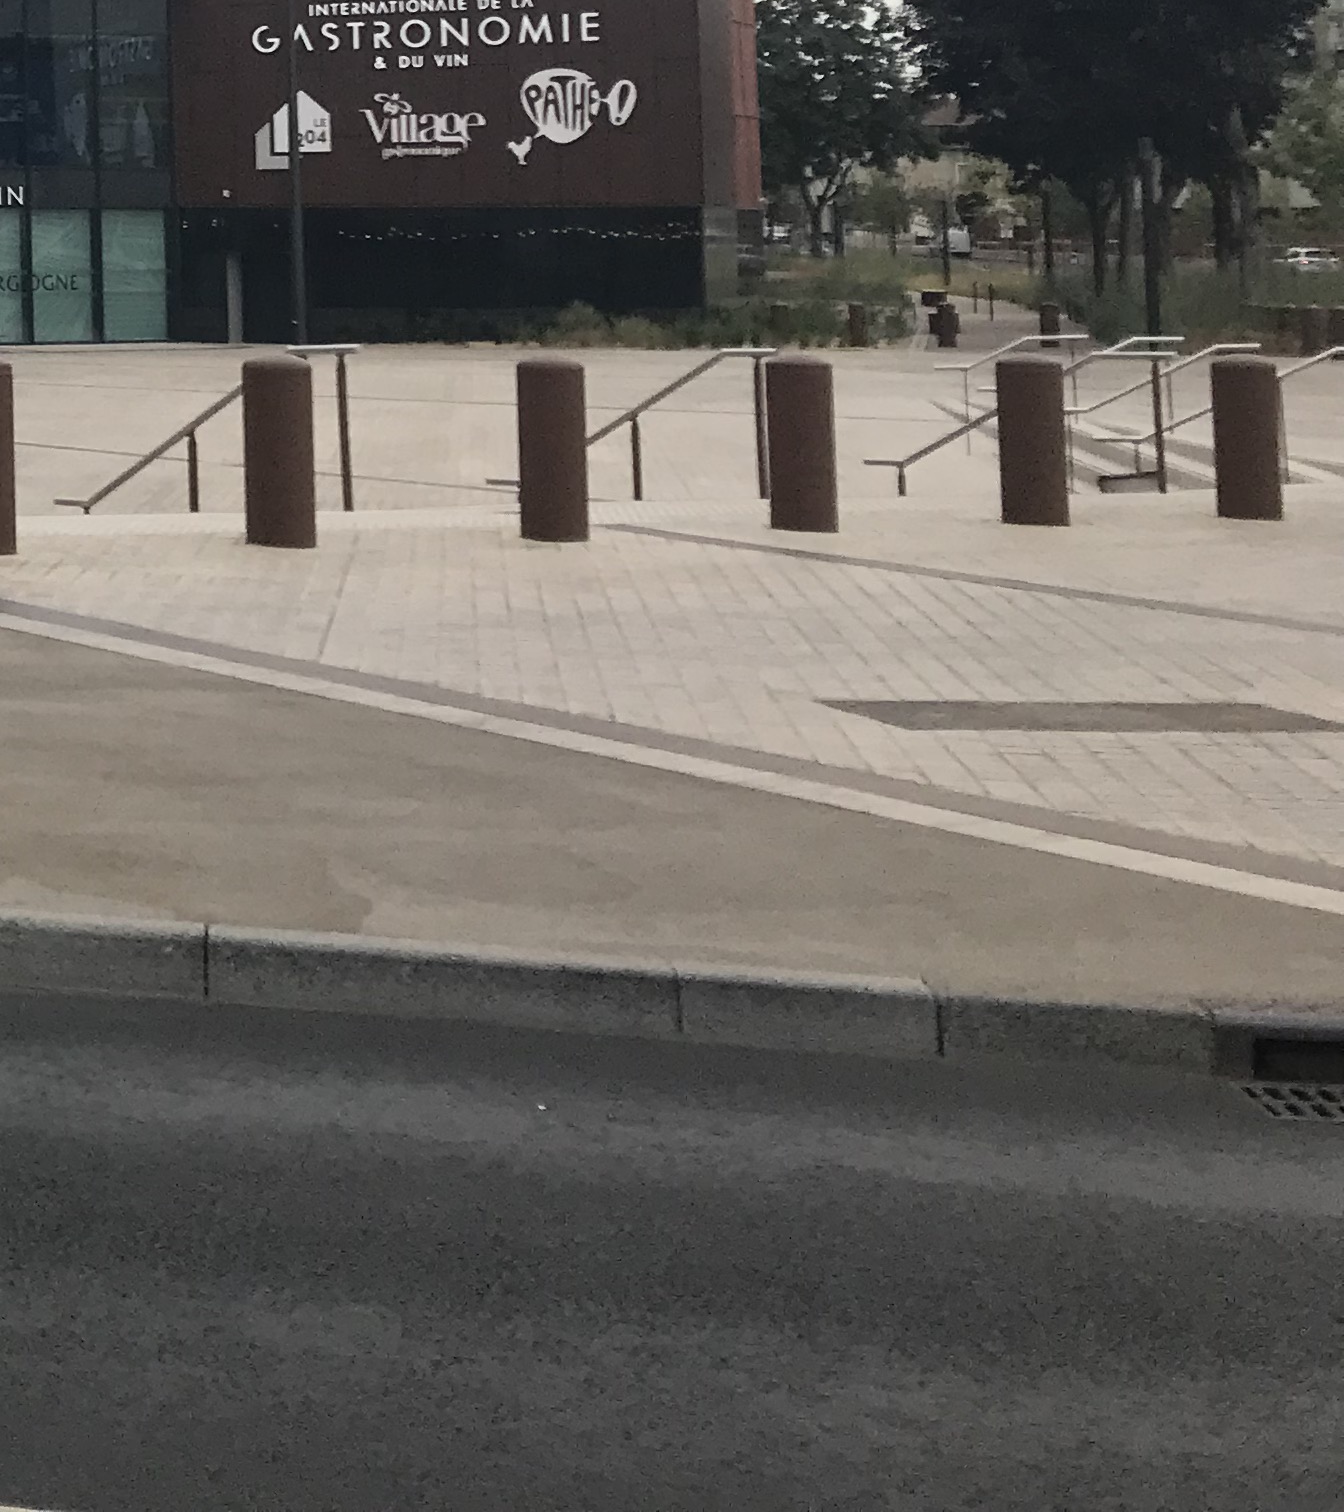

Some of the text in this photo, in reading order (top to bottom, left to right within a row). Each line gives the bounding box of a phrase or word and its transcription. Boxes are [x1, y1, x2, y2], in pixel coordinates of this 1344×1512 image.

[251, 11, 601, 54] GASTRONOMIE
[373, 53, 468, 70] & DU VIN
[313, 118, 327, 128] LE
[358, 108, 487, 148] Village
